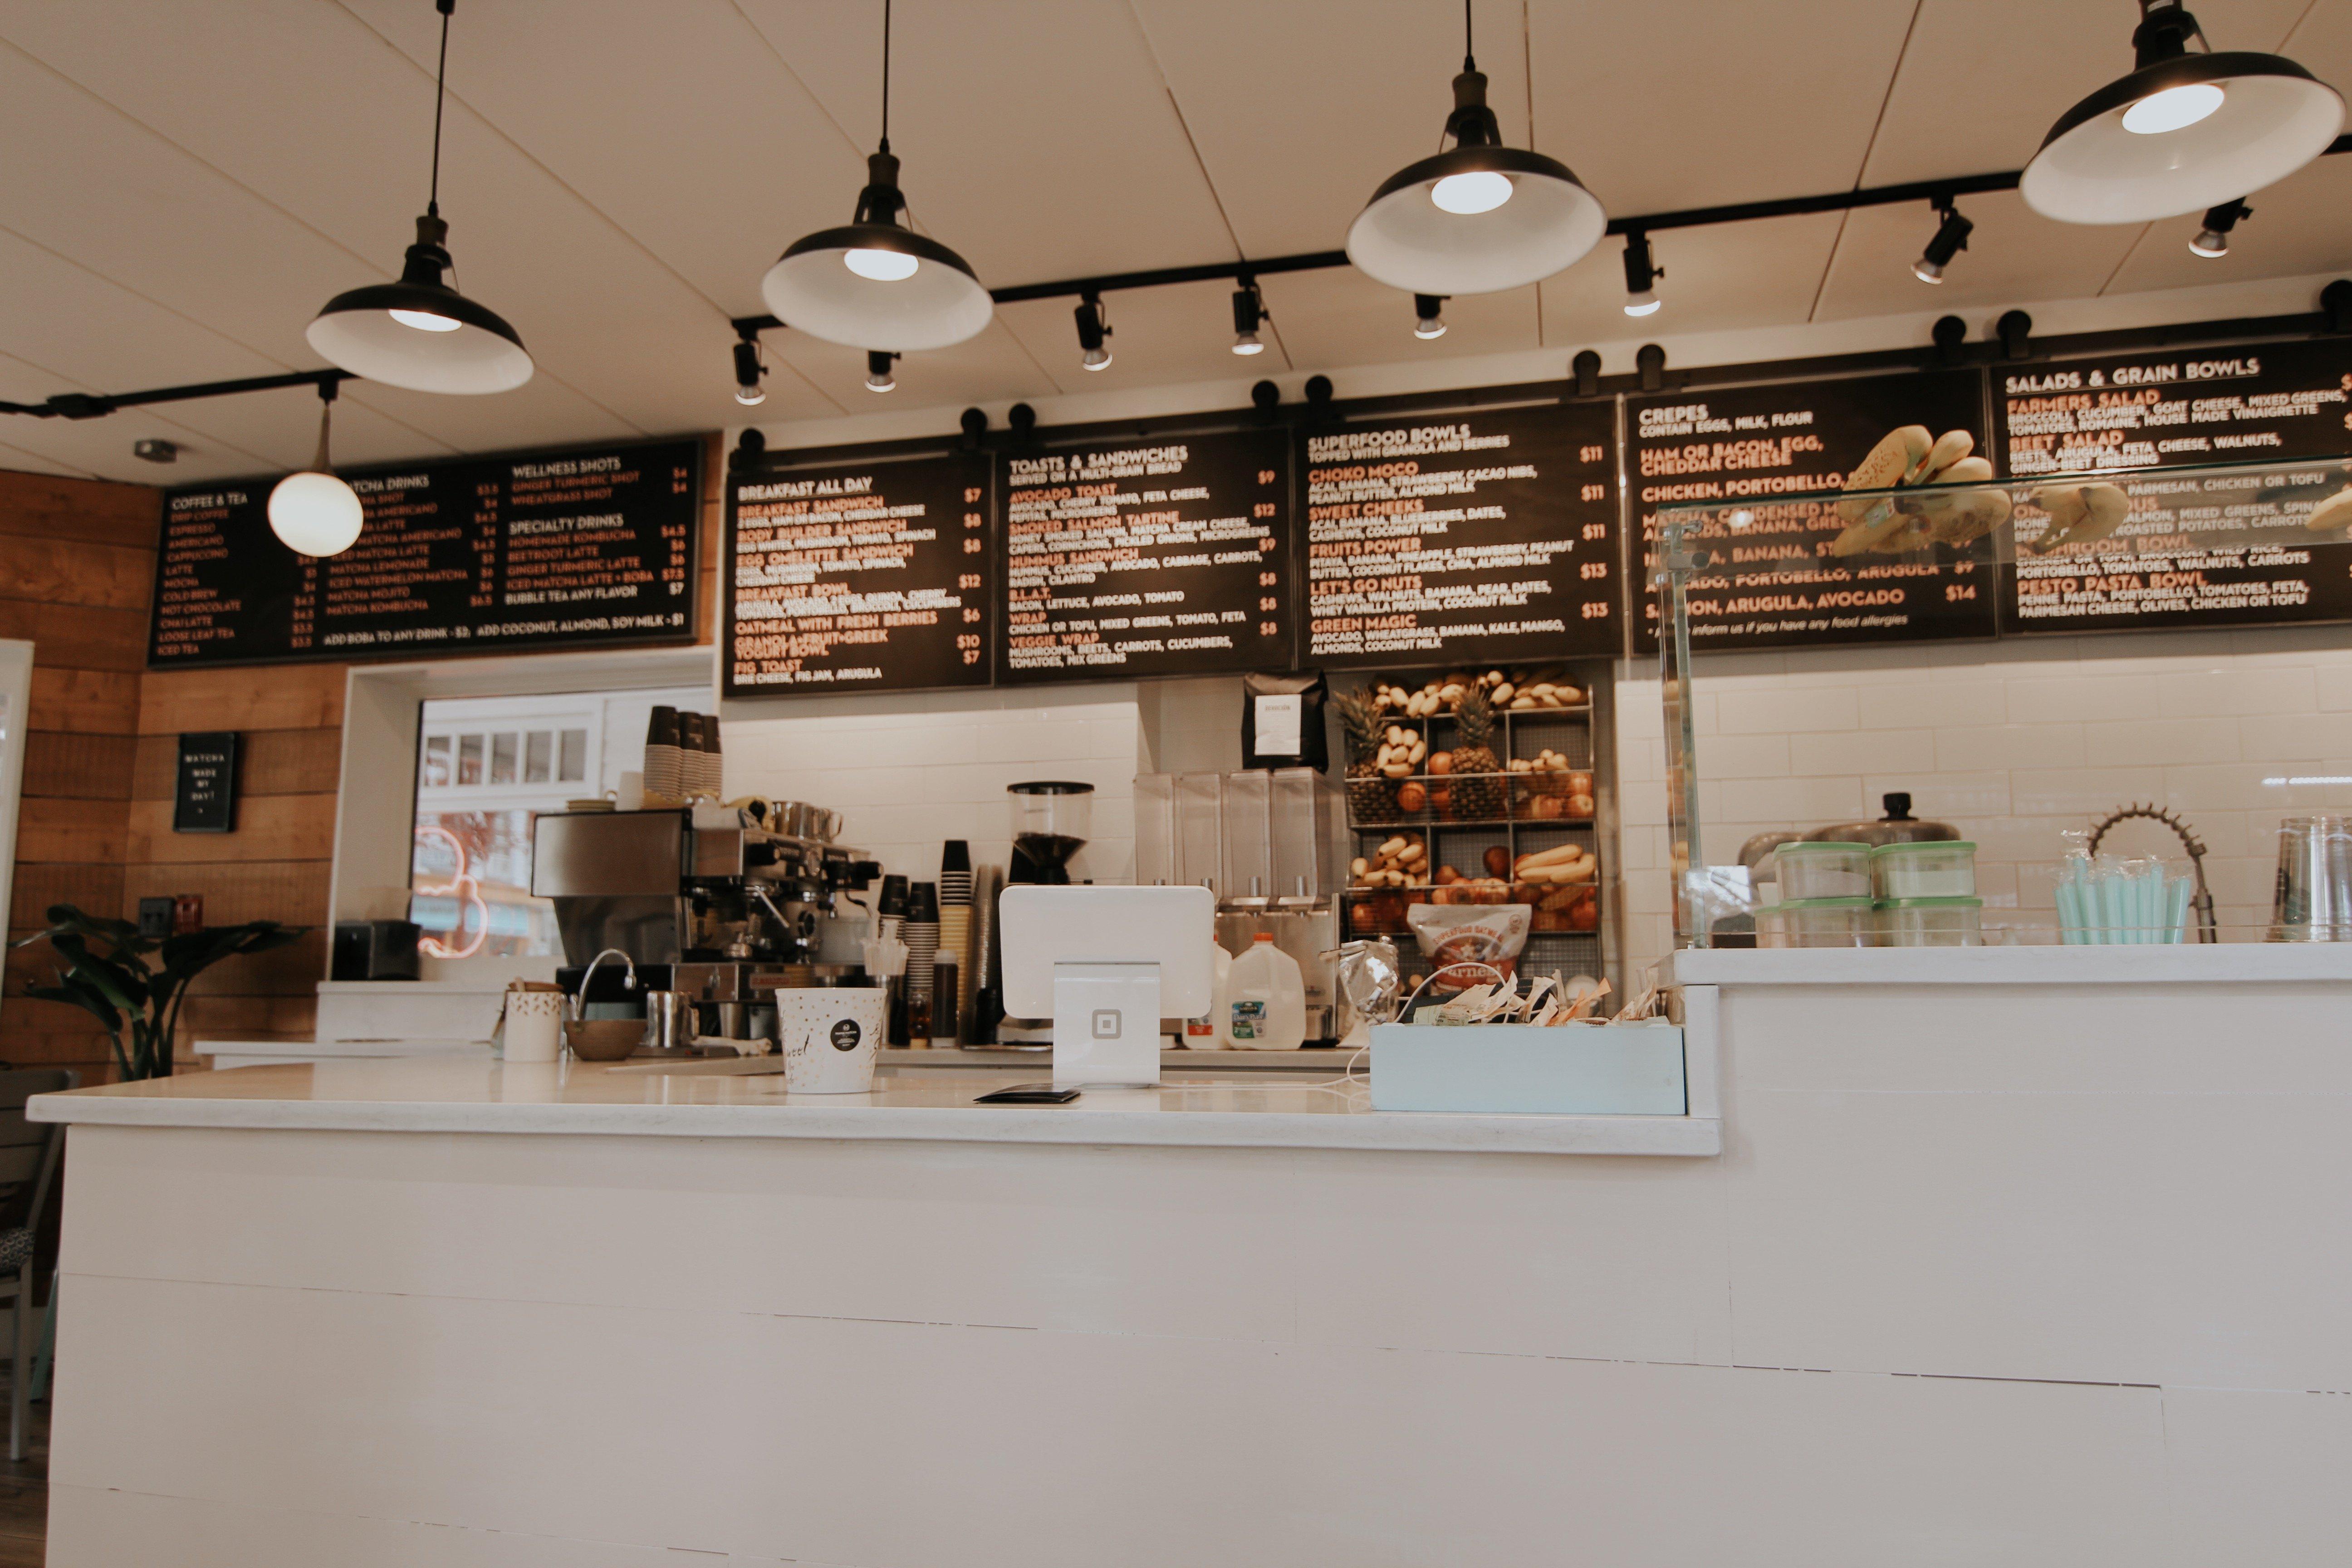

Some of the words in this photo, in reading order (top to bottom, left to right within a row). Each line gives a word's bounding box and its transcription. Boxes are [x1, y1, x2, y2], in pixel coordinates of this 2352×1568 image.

[2006, 371, 2081, 394] SALADS
[2088, 369, 2105, 387] &
[2112, 363, 2177, 386] GRAIN
[2186, 356, 2259, 380] BOWLS
[2007, 393, 2092, 416] FARMERS
[2098, 388, 2159, 409] SALAD
[1639, 404, 1708, 426] CREPES
[1640, 421, 1692, 440] CONTAIN
[1735, 413, 1768, 431] MILK,
[1772, 408, 1813, 427] FLOUR
[1308, 430, 1406, 452] SUPERFOOD
[1411, 424, 1470, 442] BOWLS
[2009, 434, 2055, 452] BEET
[2063, 429, 2124, 448] SALAD
[2122, 441, 2156, 456] FETA
[2158, 436, 2211, 454] CHEESE,
[2214, 431, 2283, 450] WALNUTS,
[1580, 444, 1602, 463] $11
[1642, 446, 1680, 465] HAM
[1683, 442, 1709, 461] OR
[1712, 437, 1776, 461] BACON,
[1780, 434, 1823, 455] EGG,
[512, 461, 577, 479] WELLNESS
[579, 456, 621, 474] SHOTS
[1009, 456, 1065, 475] TOASTS
[1070, 455, 1082, 470] &
[1088, 446, 1188, 468] SANDWICHES
[1641, 456, 1722, 478] CHEDDAR
[1724, 450, 1792, 470] CHEESE
[386, 474, 430, 490] DRINKS
[1258, 470, 1275, 484] $9
[1309, 466, 1365, 485] CHOKO
[1367, 461, 1418, 480] MOCO
[738, 480, 815, 501] BREAKFAST
[817, 478, 843, 495] ALL
[844, 476, 872, 493] DAY
[1010, 487, 1071, 504] AVOCADO
[1075, 483, 1117, 498] TOAST
[1581, 483, 1604, 502] $11
[1642, 481, 1722, 505] CHICKEN,
[1725, 470, 1845, 498] PORTOBELLO,
[2127, 479, 2201, 498] PARMESAN,
[2204, 475, 2261, 492] CHICKEN
[2264, 473, 2286, 488] OR
[2289, 470, 2326, 487] TOFU
[171, 493, 214, 510] COFFEE
[228, 490, 248, 505] TEA
[964, 488, 981, 503] $7
[736, 501, 809, 518] BREAKFAST
[812, 495, 884, 513] SANDWICH
[1254, 502, 1275, 517] $12
[1309, 503, 1360, 522] SWEET
[1363, 498, 1424, 517] CHEEKS
[509, 516, 574, 535] SPECIALTY
[576, 513, 623, 530] DRINKS
[736, 528, 773, 543] BODY
[777, 524, 832, 540] BUILDER
[835, 518, 906, 536] SANDWICH
[964, 513, 981, 529] $8
[1009, 520, 1062, 536] SMOKED
[1067, 515, 1122, 531] SALMON
[1125, 510, 1180, 527] TARTINE
[1583, 524, 1605, 539] $11
[735, 552, 764, 568] EGG
[768, 547, 838, 565] OMELETTE
[841, 542, 913, 561] SANDWICH
[964, 538, 980, 554] $8
[1259, 537, 1275, 552] $9
[1309, 541, 1362, 559] FRUITS
[1364, 536, 1421, 555] POWER
[1733, 543, 1809, 564] BANANA,
[1009, 552, 1065, 568] HUMMUS
[1069, 547, 1138, 564] SANDWICH
[2017, 562, 2102, 579] PORTOBELLO,
[2102, 558, 2174, 575] TOMATOES,
[2177, 554, 2244, 571] WALNUTS,
[2248, 550, 2310, 566] CARROTS
[1049, 572, 1096, 586] CILANTRO
[1260, 571, 1276, 587] $8
[1580, 561, 1607, 579] $13
[669, 582, 684, 595] $7
[959, 573, 980, 589] $12
[1310, 580, 1350, 597] LET'S
[1353, 578, 1378, 593] GO
[1382, 574, 1422, 591] NUTS
[2017, 577, 2078, 595] PESTO
[2085, 574, 2142, 592] PASTA
[2150, 570, 2209, 588] BOWL
[504, 590, 545, 605] BUBBLE
[548, 589, 568, 602] TEA
[570, 588, 593, 601] ANY
[593, 585, 637, 599] FLAVOR
[735, 584, 808, 602] BREAKFAST
[811, 582, 851, 597] BOWL
[1046, 596, 1089, 611] LETTUCE,
[1092, 593, 1142, 608] AVOCADO,
[1143, 590, 1185, 603] TOMATO
[1726, 593, 1814, 614] ARUGULA,
[1817, 588, 1905, 608] AVOCADO
[1945, 583, 1975, 603] $14
[1260, 596, 1276, 612] $8
[1582, 602, 1607, 618] $13
[611, 616, 634, 629] SOY
[635, 614, 664, 628] MILK
[735, 618, 797, 635] OATMEAL
[797, 617, 832, 632] WITH
[836, 614, 879, 629] FRESH
[883, 610, 938, 627] BERRIES
[963, 608, 980, 623] $6
[1009, 611, 1047, 625] WRAP
[1312, 617, 1362, 634] GREEN
[1365, 613, 1416, 631] MAGIC
[1692, 622, 1729, 635] inform
[1731, 621, 1744, 633] us
[1746, 621, 1756, 633] if
[1756, 621, 1778, 635] you
[1780, 618, 1806, 631] have
[1808, 618, 1829, 631] any
[1832, 616, 1859, 629] food
[1861, 613, 1908, 628] allergies
[956, 633, 980, 649] $10
[1009, 635, 1056, 648] VEGGIE
[1061, 632, 1099, 645] WRAP
[1114, 639, 1164, 654] CARROTS,
[1167, 635, 1233, 651] CUCUMBERS,
[1310, 641, 1364, 656] ALMONDS,
[1364, 638, 1416, 652] COCONUT
[1416, 636, 1442, 649] MILK
[733, 661, 756, 675] FIG
[760, 659, 803, 674] TOAST
[963, 650, 980, 665] $7
